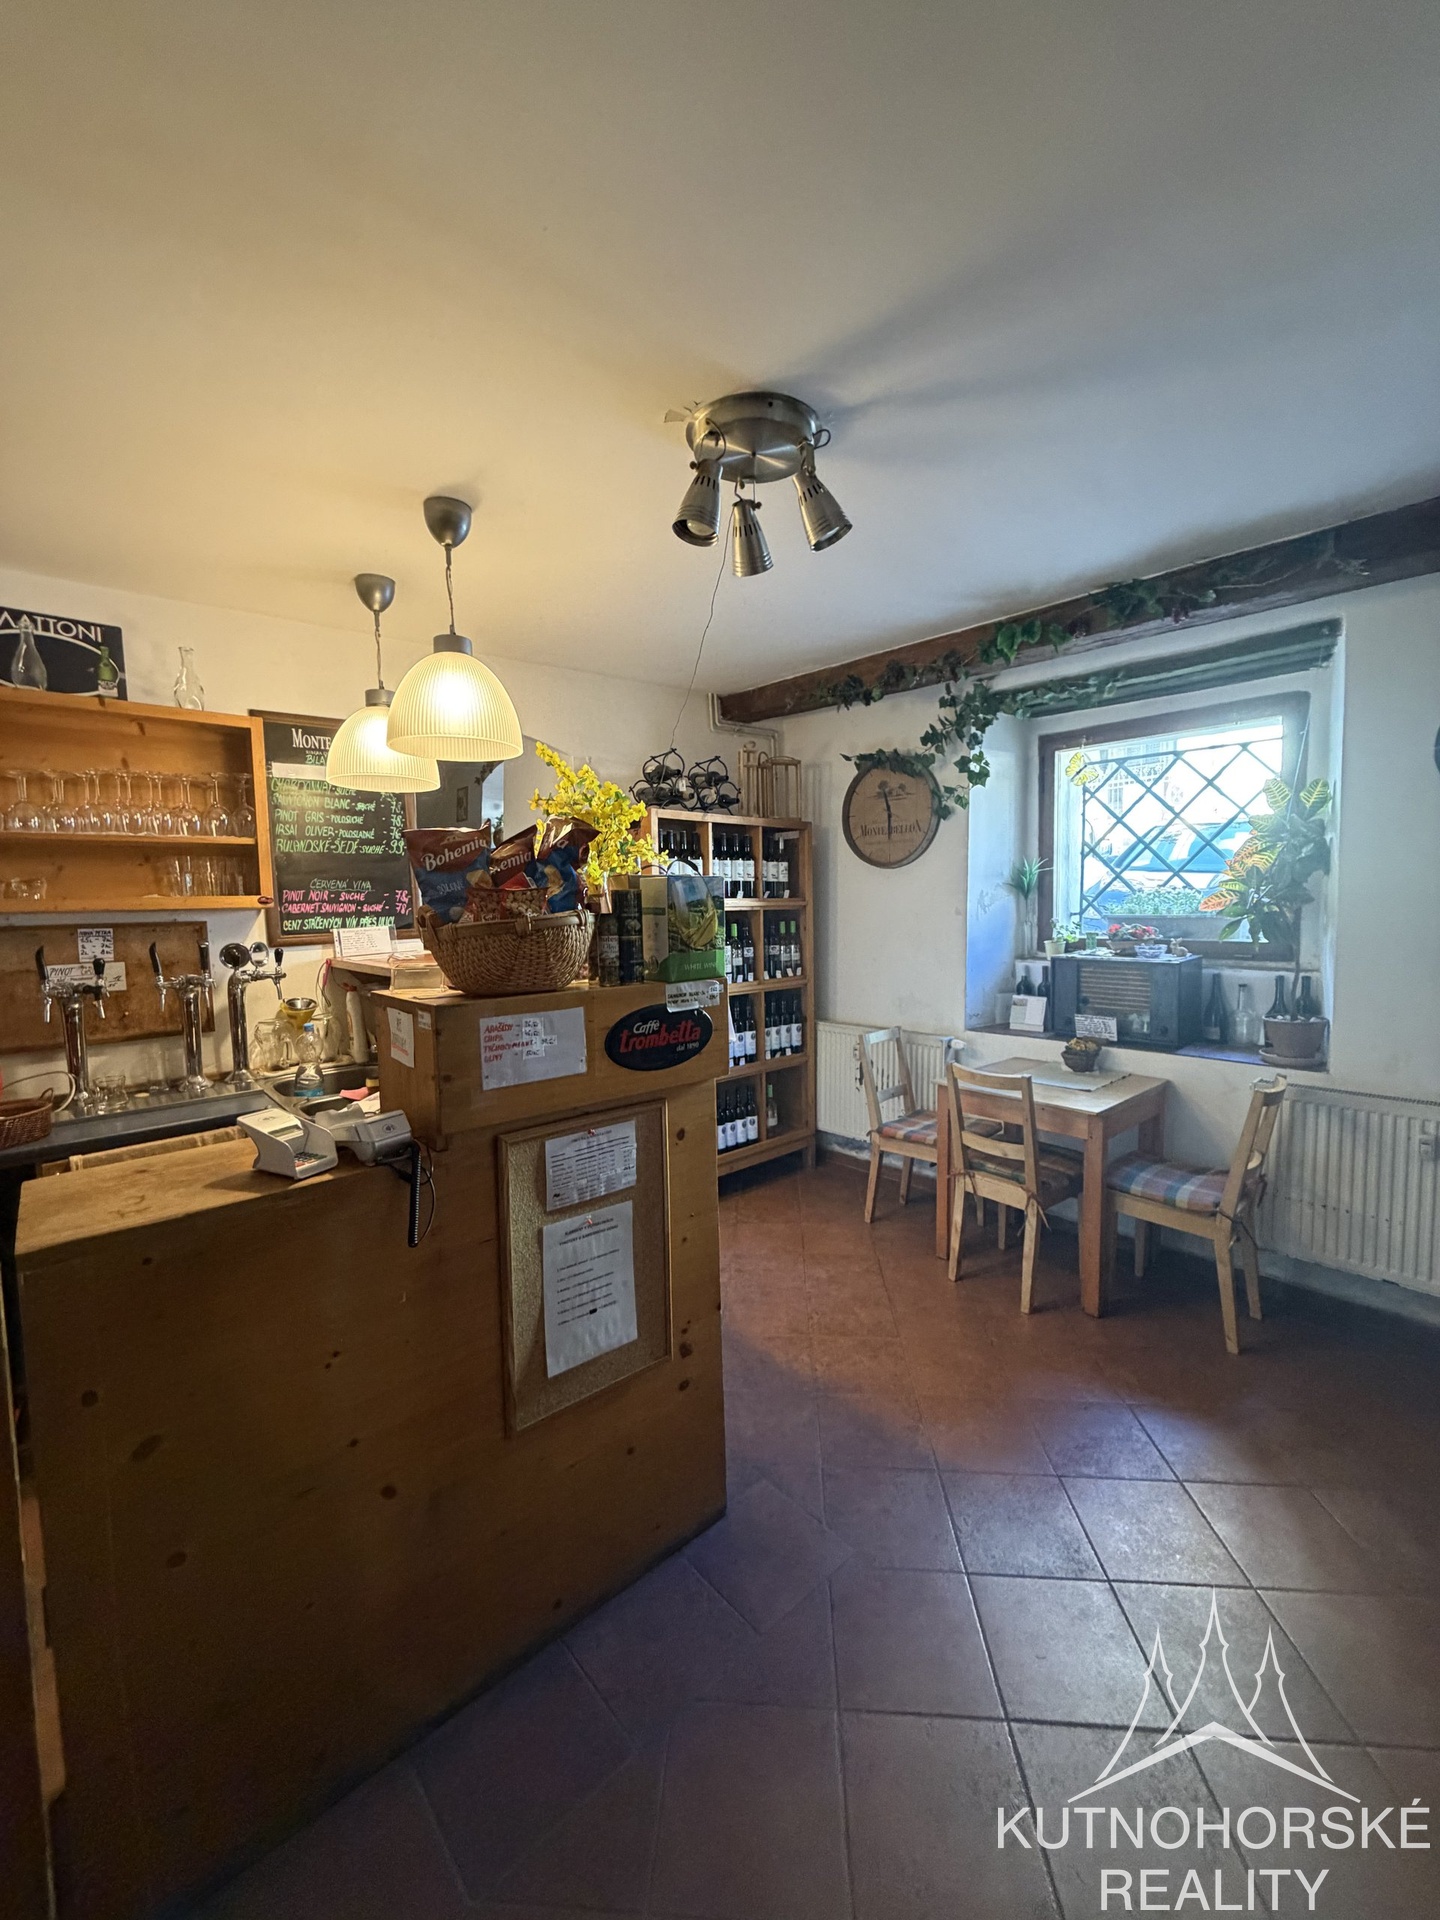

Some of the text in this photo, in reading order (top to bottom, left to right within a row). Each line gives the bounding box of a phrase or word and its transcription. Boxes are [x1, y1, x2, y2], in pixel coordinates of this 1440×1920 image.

[324, 797, 350, 810] BLANC
[274, 809, 299, 822] PINOT
[305, 810, 325, 823] GRIS
[421, 837, 487, 872] Bohemia
[282, 890, 305, 902] PINOT
[308, 890, 328, 902] NOIR
[281, 902, 321, 914] CABERNET
[320, 903, 356, 914] SAUVIGNON
[282, 919, 302, 932] CENY
[633, 1020, 660, 1035] Caffè
[620, 1020, 701, 1053] trombetta
[676, 1043, 685, 1052] dal
